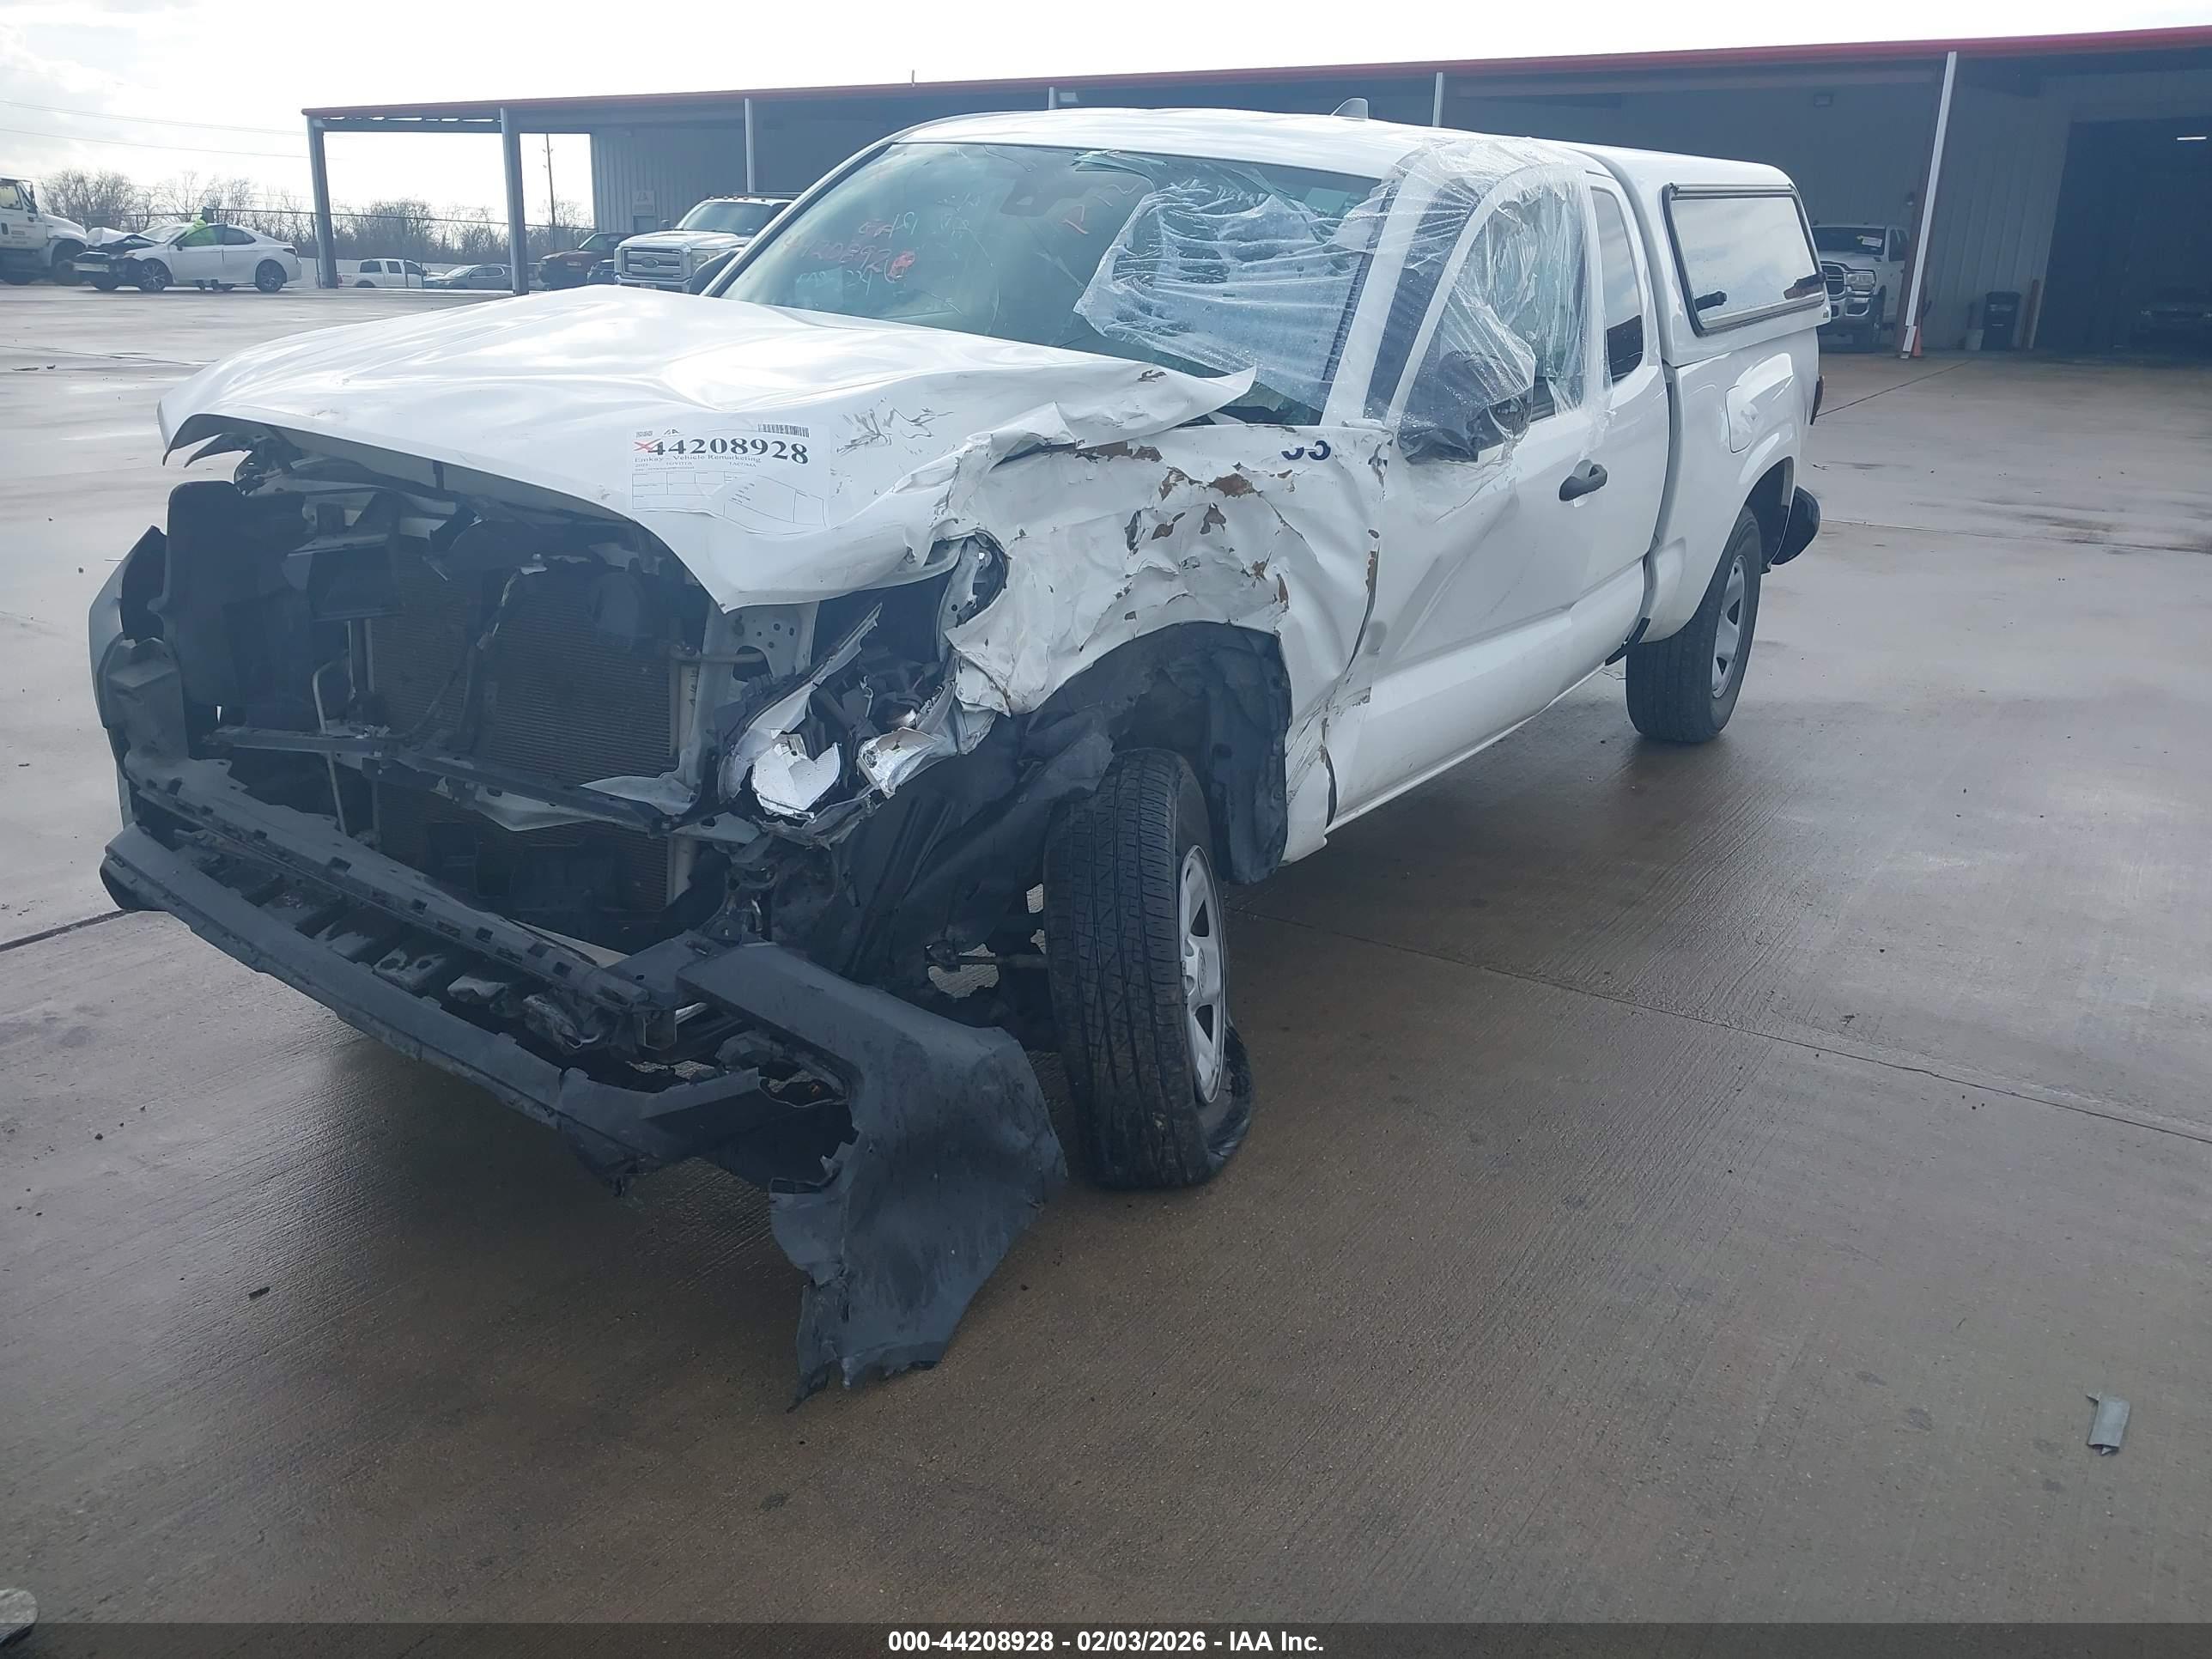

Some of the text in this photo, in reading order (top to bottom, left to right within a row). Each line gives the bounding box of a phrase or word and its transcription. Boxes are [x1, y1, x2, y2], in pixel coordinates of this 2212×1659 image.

[635, 455, 665, 464] Emkay
[708, 454, 762, 464] Remarketing
[647, 438, 809, 465] 44208928
